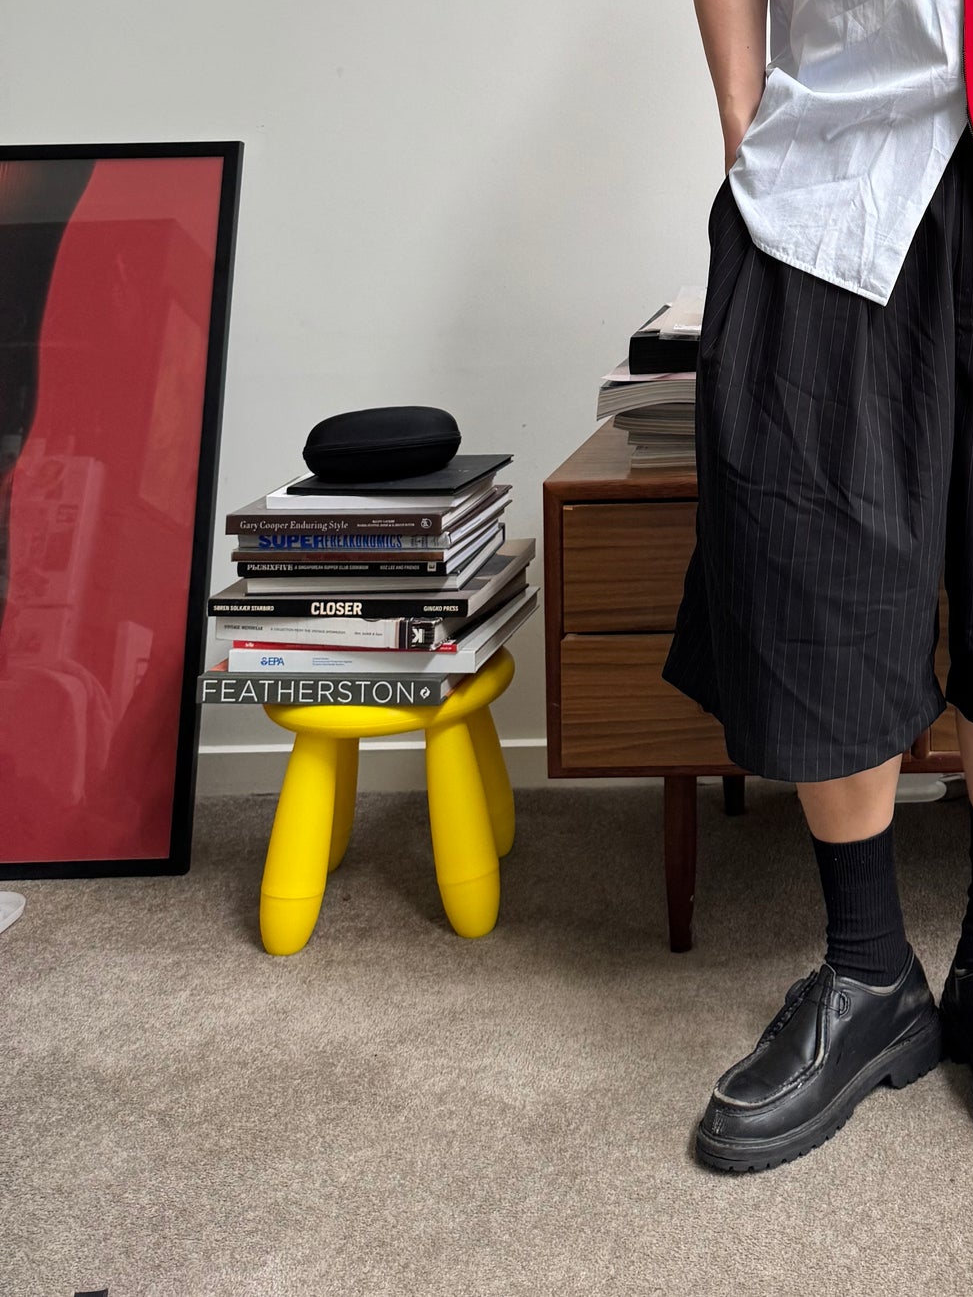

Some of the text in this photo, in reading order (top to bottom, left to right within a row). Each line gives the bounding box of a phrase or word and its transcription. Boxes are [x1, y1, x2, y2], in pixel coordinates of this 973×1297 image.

[240, 520, 349, 532] Gary Cooper Enduring Style
[311, 601, 363, 615] CLOSER
[268, 657, 285, 666] EPA
[202, 679, 415, 704] FEATHERSTON
